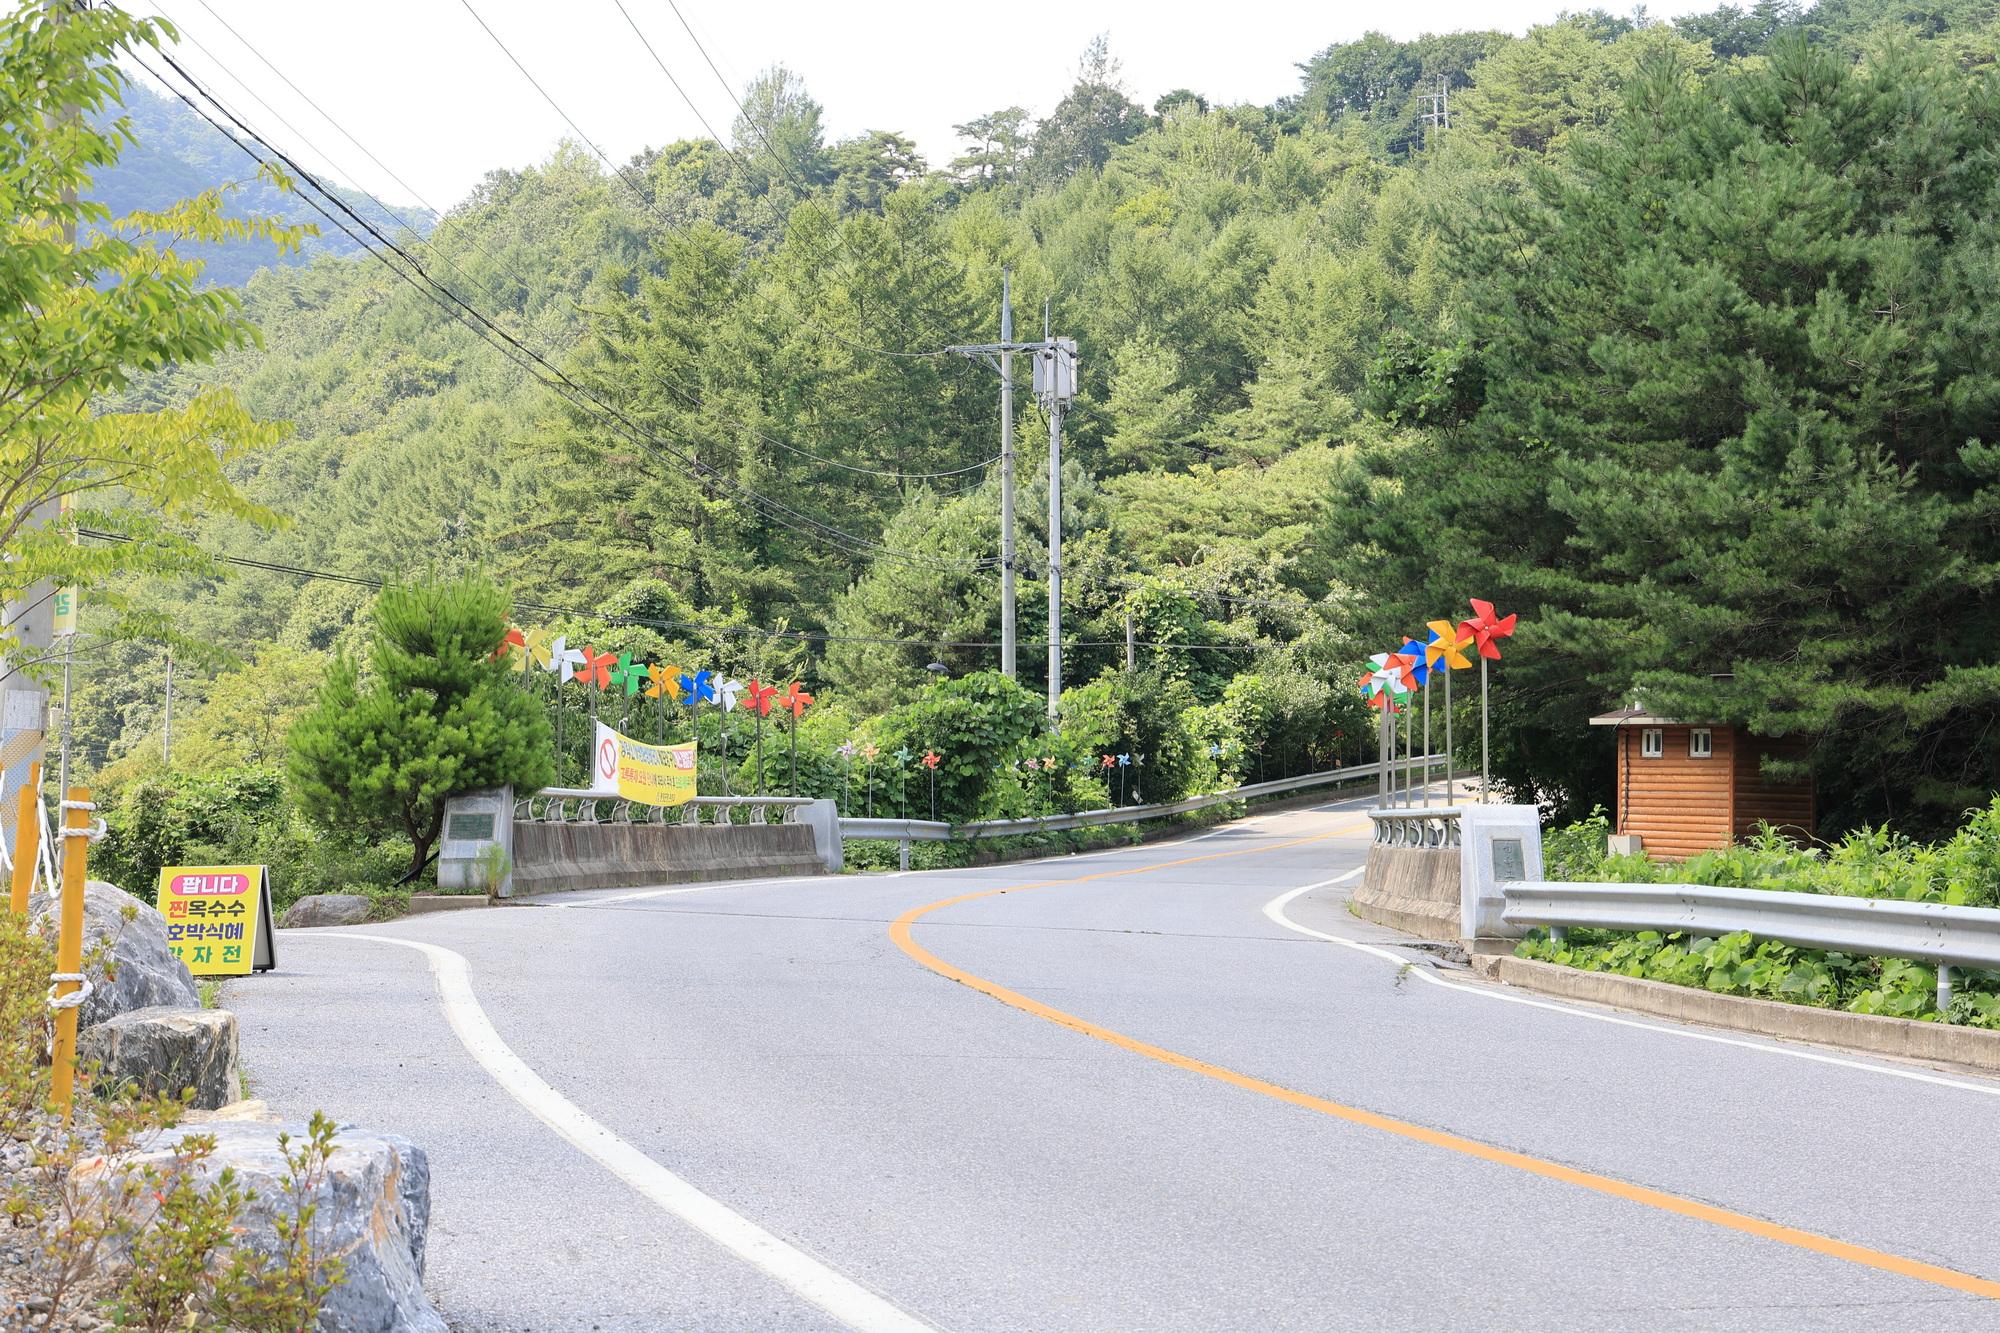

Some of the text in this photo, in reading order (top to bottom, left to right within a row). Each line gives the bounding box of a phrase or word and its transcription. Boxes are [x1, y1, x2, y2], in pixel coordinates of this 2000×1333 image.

[182, 876, 238, 894] 팝니다
[168, 899, 245, 918] 찐옥수수
[168, 922, 244, 941] 호박식혜
